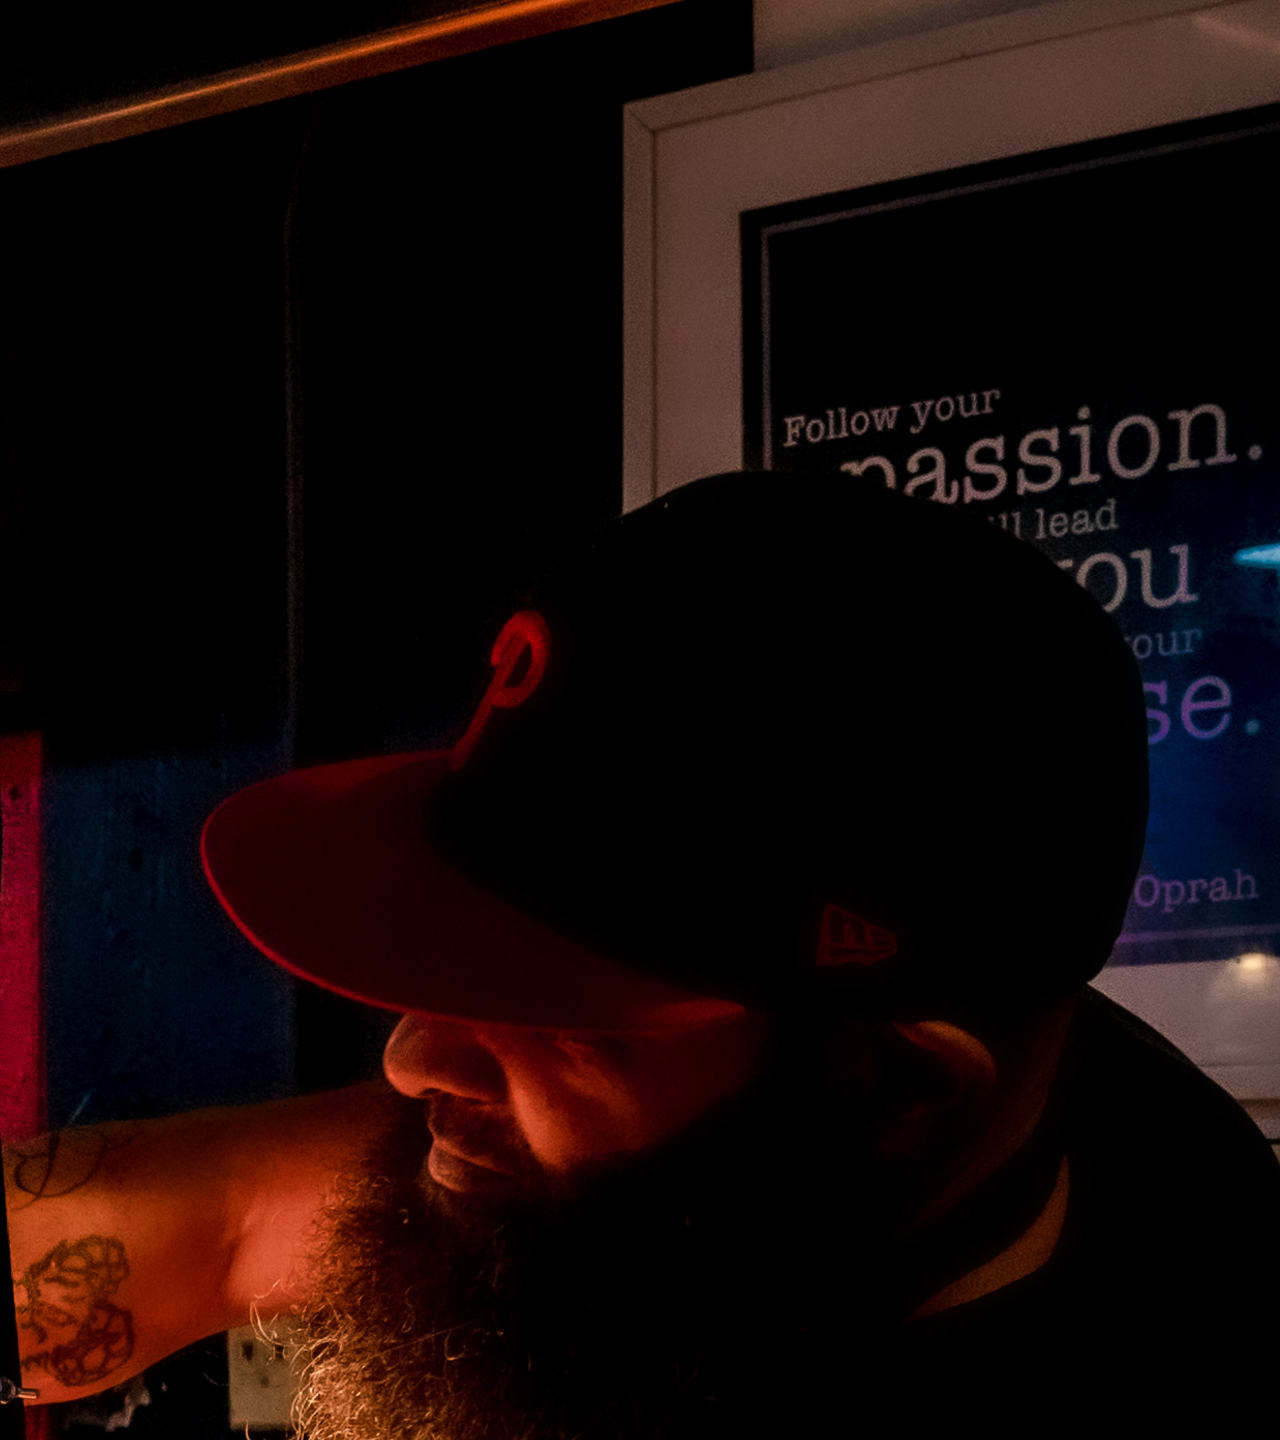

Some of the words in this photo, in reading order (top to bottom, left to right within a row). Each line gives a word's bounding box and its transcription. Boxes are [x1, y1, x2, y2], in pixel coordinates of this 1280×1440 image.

[782, 402, 902, 449] Follow
[909, 386, 1003, 437] your
[1034, 497, 1120, 540] lead
[1056, 542, 1200, 613] ou
[1122, 624, 1202, 661] our
[1133, 867, 1260, 916] Oprah
